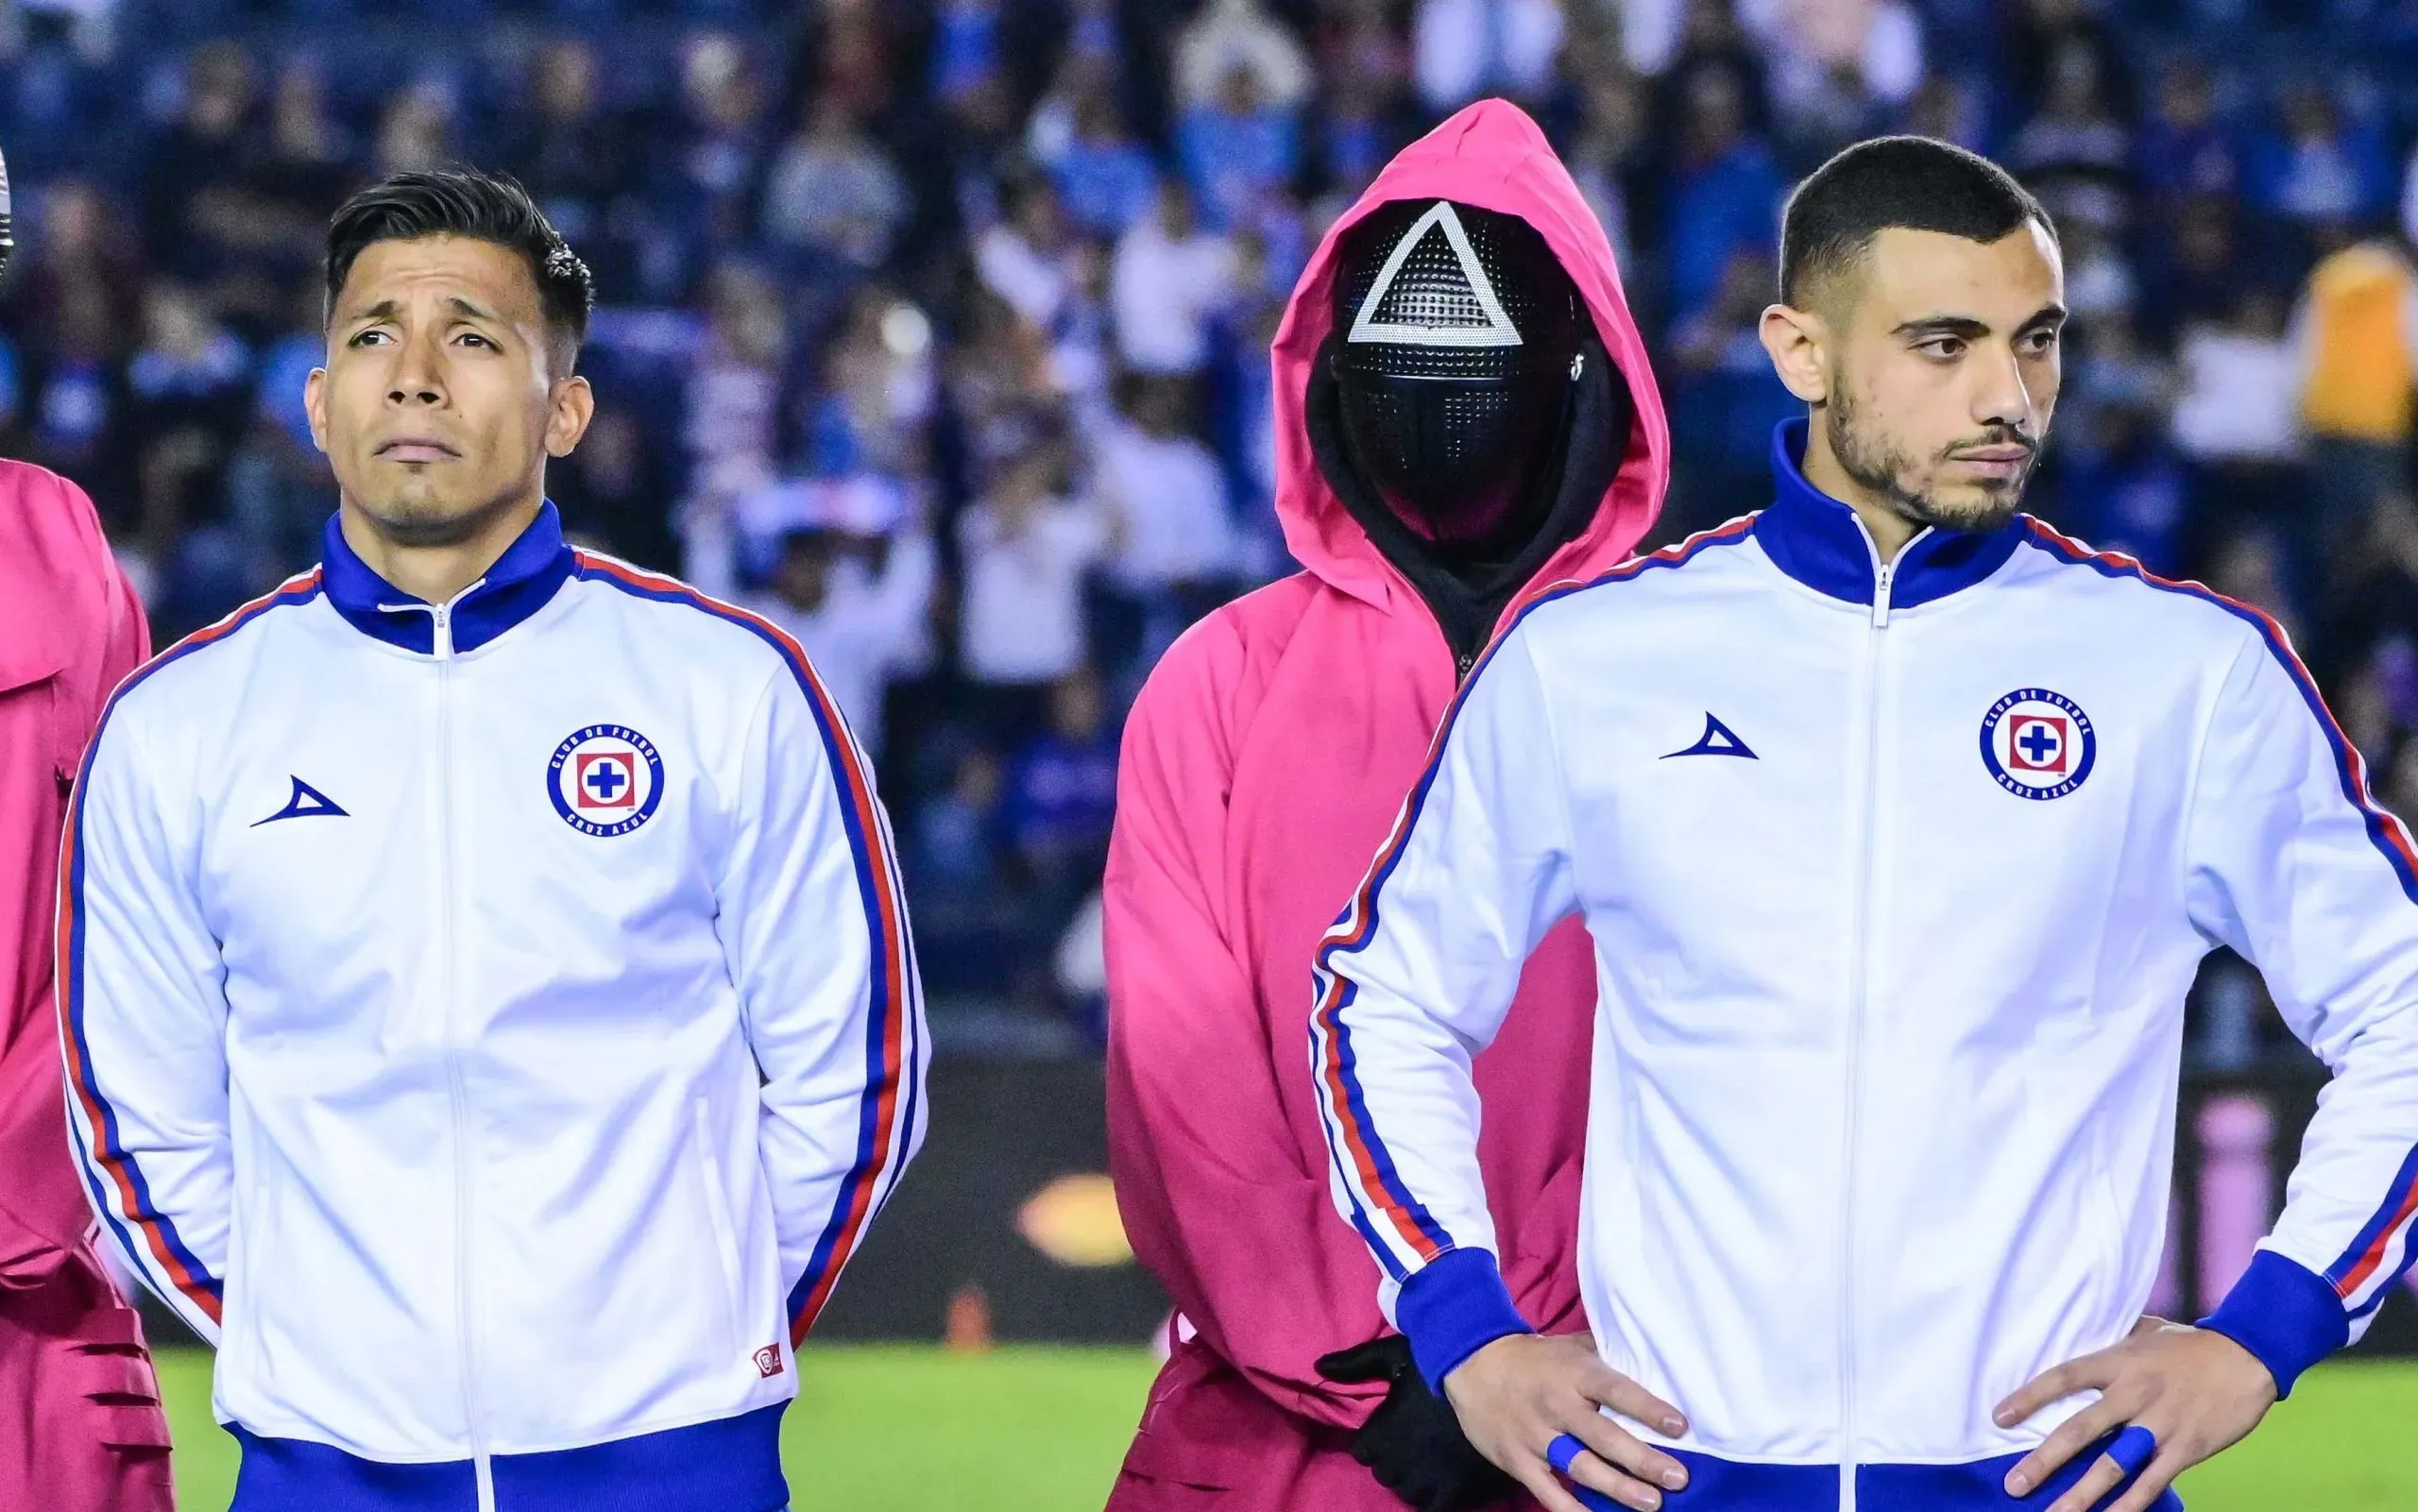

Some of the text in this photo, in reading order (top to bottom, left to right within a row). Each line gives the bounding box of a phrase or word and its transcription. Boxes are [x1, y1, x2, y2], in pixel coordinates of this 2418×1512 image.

[2019, 689, 2036, 700] DE
[2046, 692, 2091, 735] FUTBOL
[552, 726, 658, 769] CLUB DE FUTBOL
[1997, 773, 2078, 799] CRUZ AZUL
[566, 812, 648, 836] CRUZ AZUL
